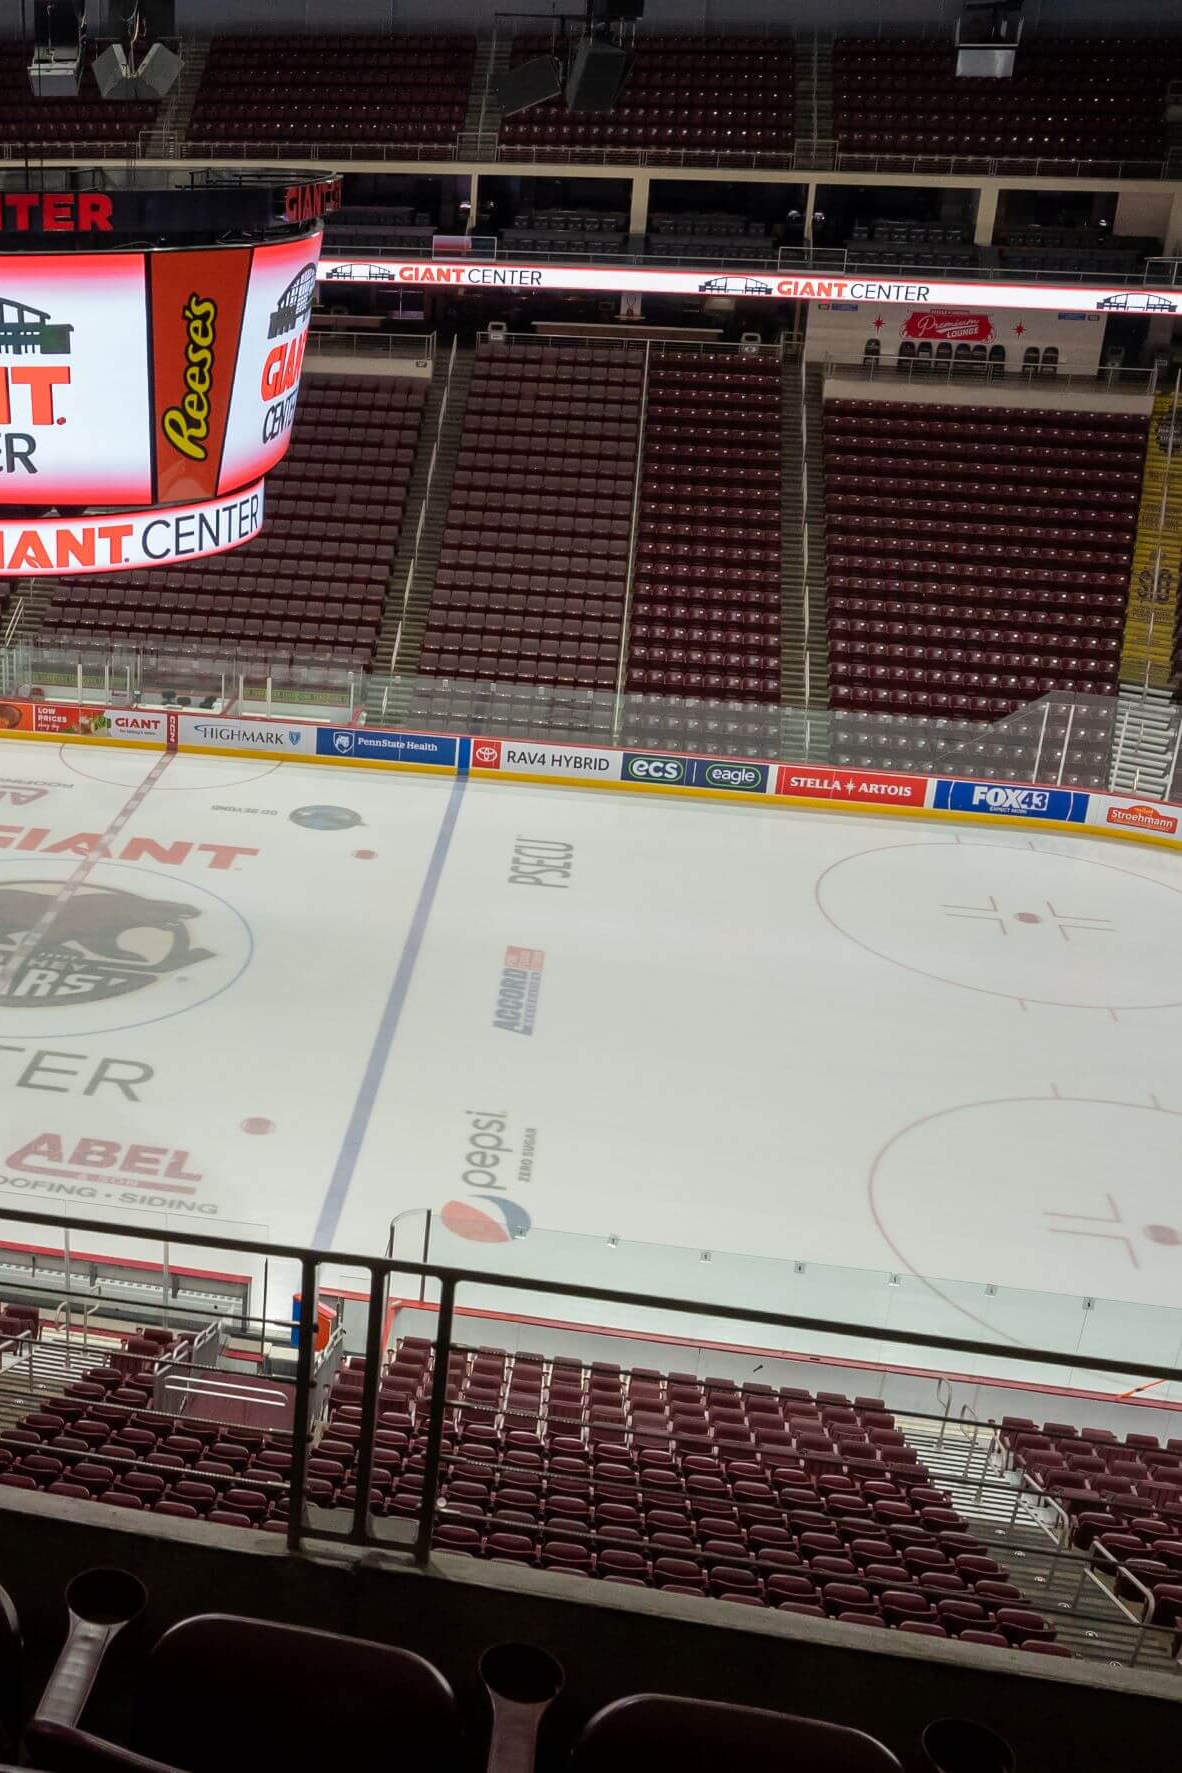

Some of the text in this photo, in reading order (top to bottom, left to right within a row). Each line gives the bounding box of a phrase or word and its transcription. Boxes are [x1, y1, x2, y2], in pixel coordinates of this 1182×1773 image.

[399, 266, 542, 286] GIANT CENTER
[777, 280, 930, 301] GIANT CENTER
[918, 315, 980, 337] Premium
[946, 327, 980, 339] LOUNGE
[161, 291, 218, 462] Reese's
[141, 493, 260, 560] CENTER
[38, 707, 56, 715] LOW
[38, 715, 67, 723] PRICES
[114, 717, 160, 730] GIANT
[202, 726, 284, 746] HIGHMARK
[406, 741, 438, 752] Health
[506, 750, 610, 772] RAV4 HYBRID
[631, 759, 678, 779] ecs
[712, 768, 756, 786] eagle
[790, 776, 913, 798] STELLA ARTOIS
[1111, 809, 1173, 830] Stroehmann
[508, 839, 574, 889] PSECU
[493, 967, 529, 1033] ACCORD
[5, 1132, 203, 1182] ABEL
[461, 1109, 513, 1191] pepsi
[518, 1127, 539, 1183] ZERO SUGAR
[118, 1192, 219, 1215] SIDING
